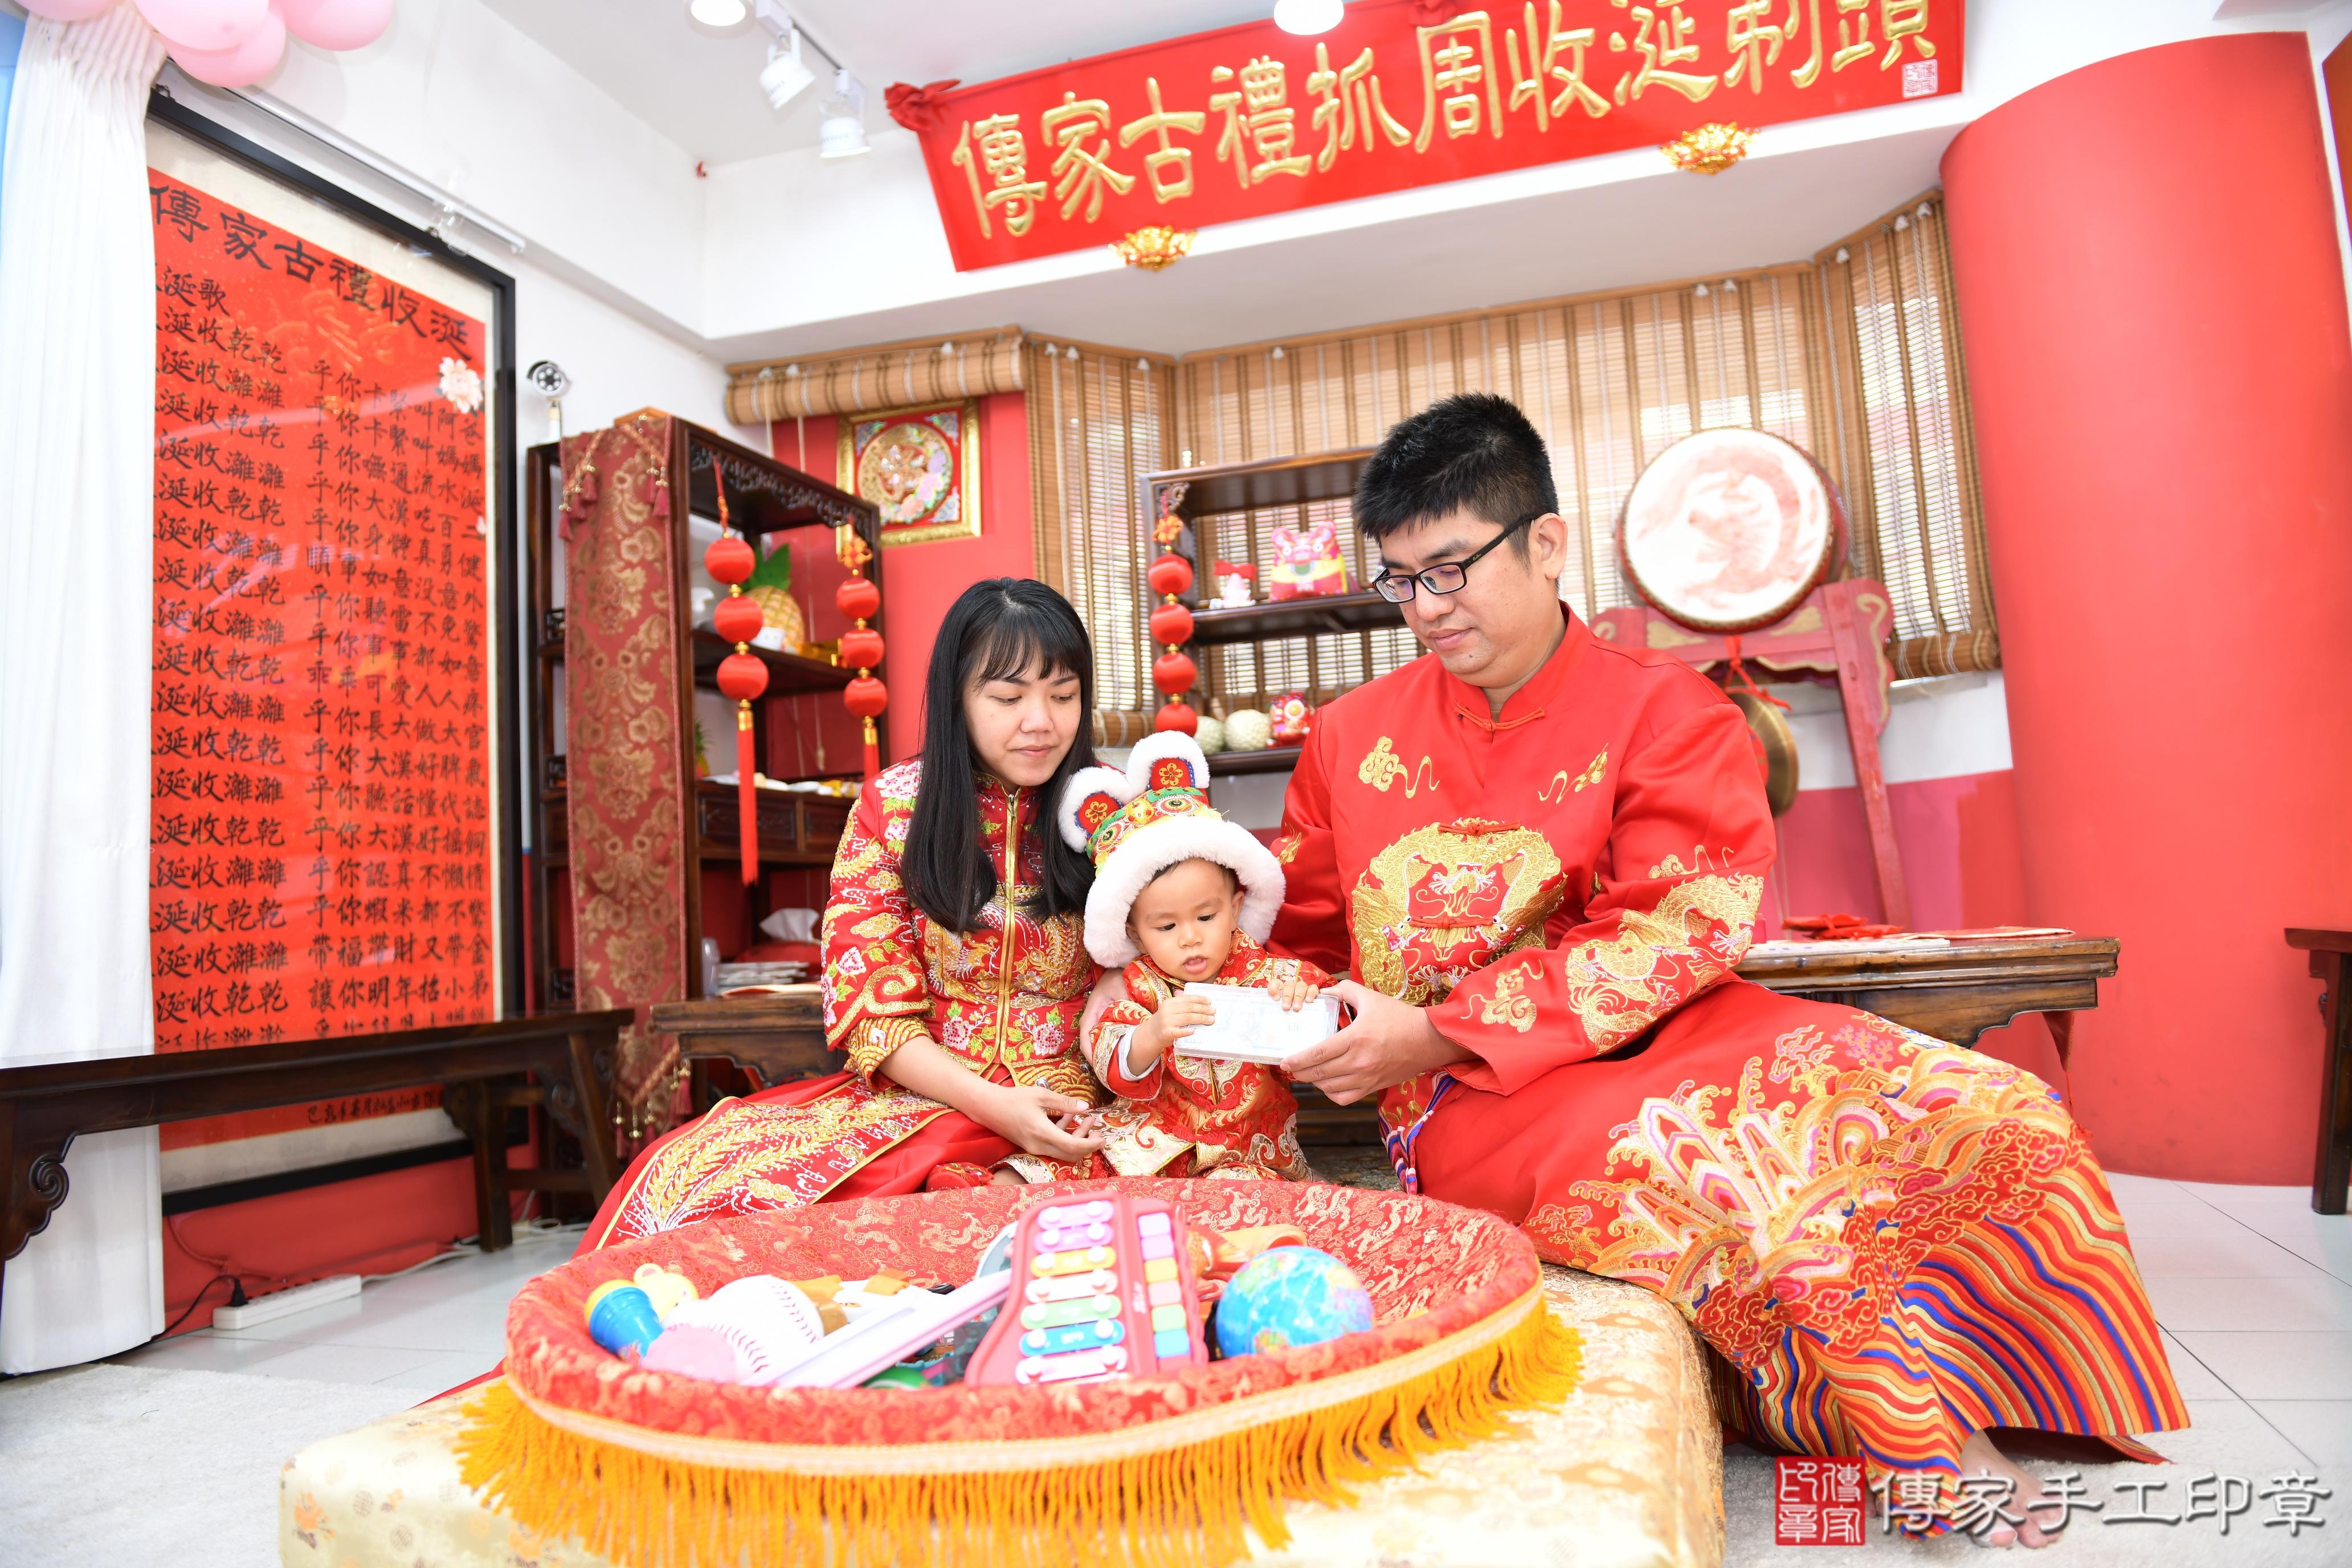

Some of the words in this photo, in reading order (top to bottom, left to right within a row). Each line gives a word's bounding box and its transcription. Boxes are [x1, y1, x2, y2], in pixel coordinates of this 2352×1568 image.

[952, 0, 1936, 238] 傳家古禮抓周收涎剃頭
[149, 185, 472, 361] 傳家古禮收涎
[156, 263, 230, 316] 涎歌
[156, 305, 287, 374] 涎收乾乾
[155, 345, 285, 409] 涎收灕灕
[154, 388, 284, 448] 涎收乾乾
[154, 428, 285, 492] 涎收灕灕
[154, 472, 285, 526] 涎收乾乾
[153, 511, 284, 566] 涎收灕灕
[153, 557, 285, 605] 涎收乾乾
[153, 595, 286, 647] 涎收灕灕
[152, 640, 285, 684] 涎收乾乾
[151, 681, 285, 725] 涎收灕灕
[151, 725, 285, 765] 涎收乾乾
[151, 767, 285, 805] 涎收灕灕
[150, 811, 285, 847] 涎收乾乾
[149, 854, 287, 889] 涎收灕灕
[149, 896, 287, 933] 涎收乾乾
[152, 941, 288, 978] 涎收灕灕
